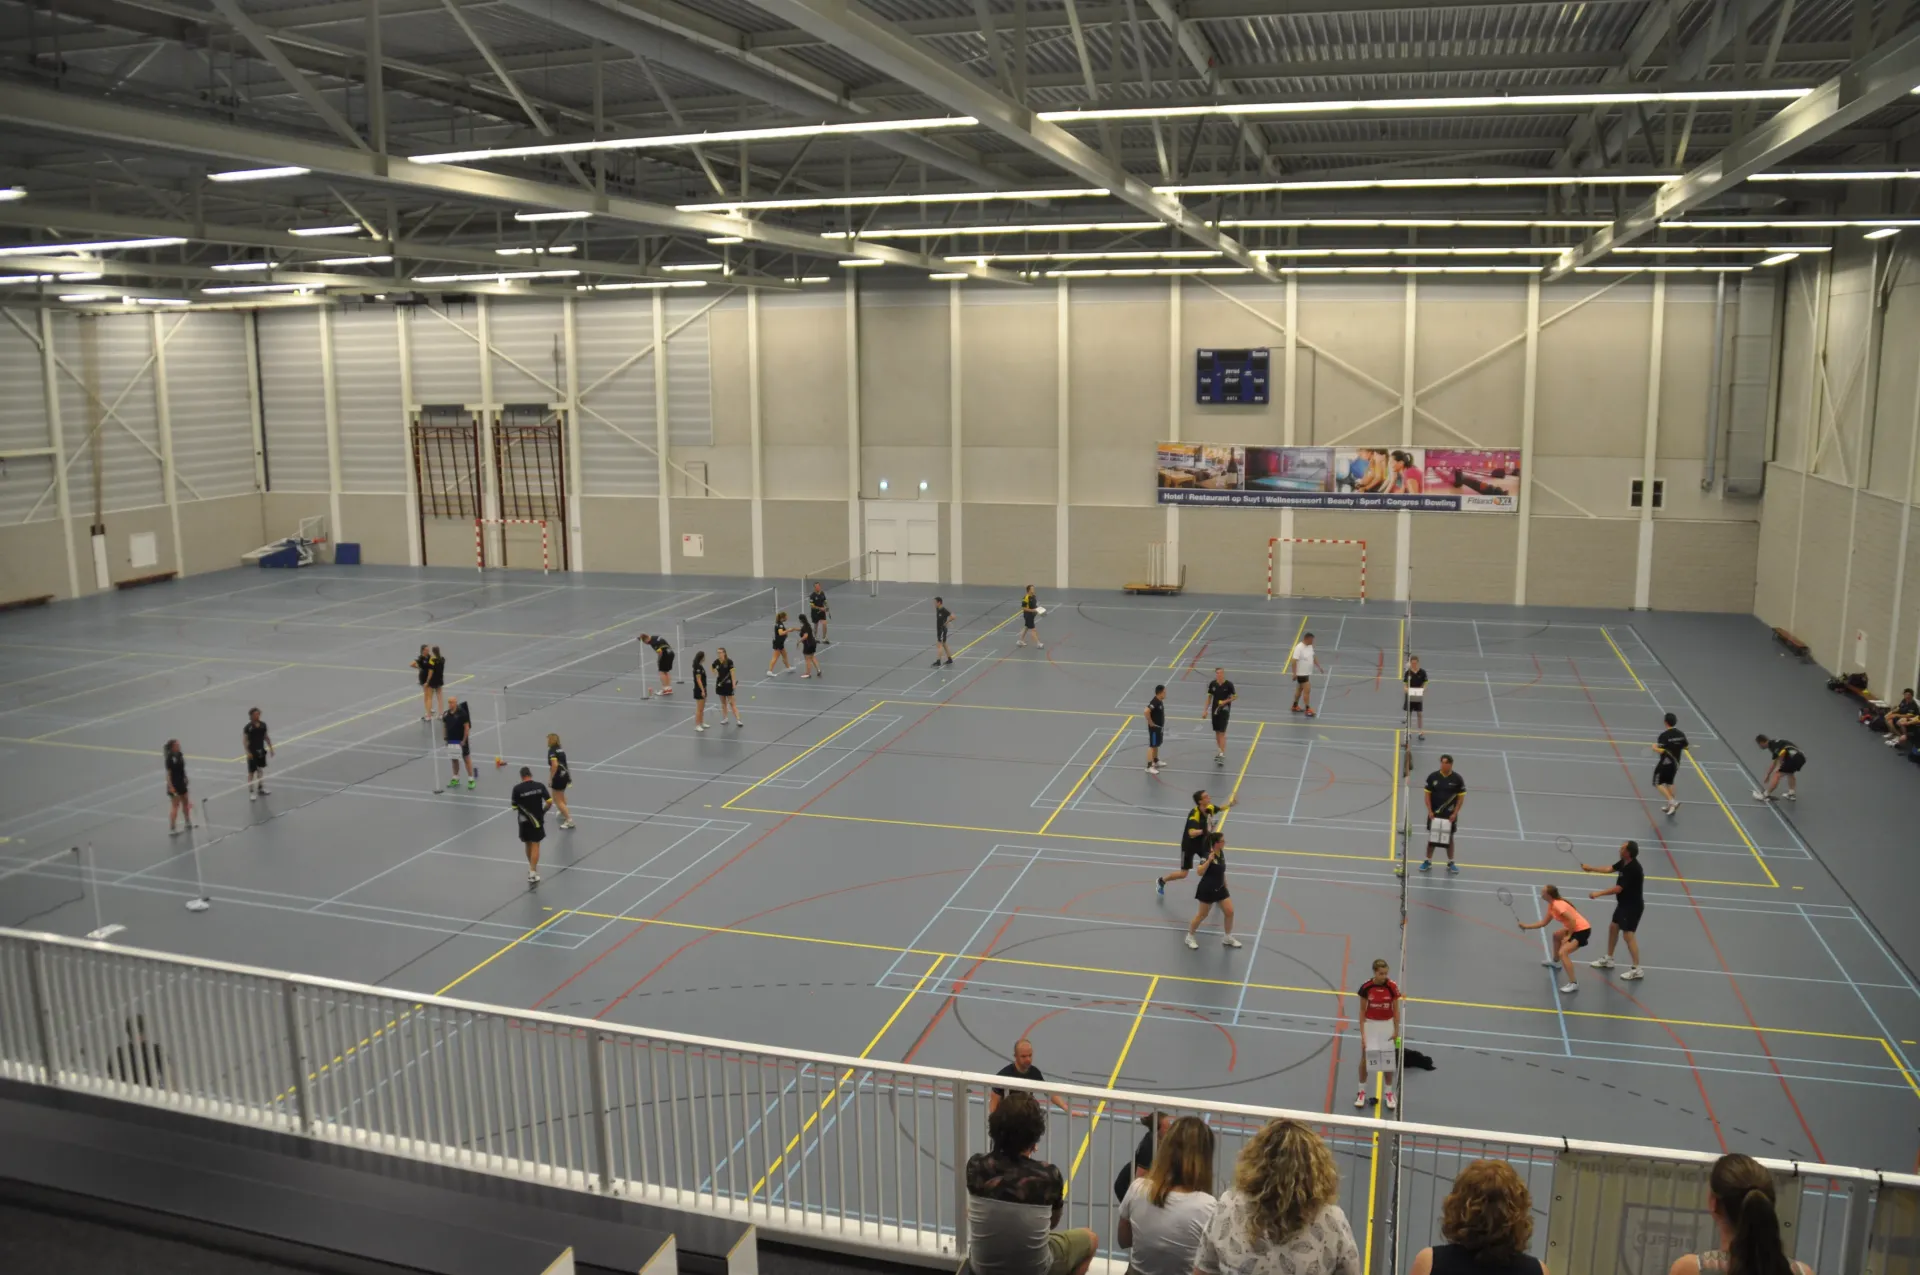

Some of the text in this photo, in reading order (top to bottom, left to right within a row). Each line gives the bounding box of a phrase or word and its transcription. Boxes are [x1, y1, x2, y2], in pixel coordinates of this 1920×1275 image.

[1163, 492, 1184, 500] Hotel
[1188, 493, 1230, 502] Restaurant
[1231, 496, 1242, 504] op
[1265, 496, 1322, 505] Wellnessresort
[1327, 497, 1354, 506] Beauty
[1359, 497, 1381, 506] Sport
[1386, 498, 1419, 507] Congres
[1425, 498, 1456, 508] Bowling
